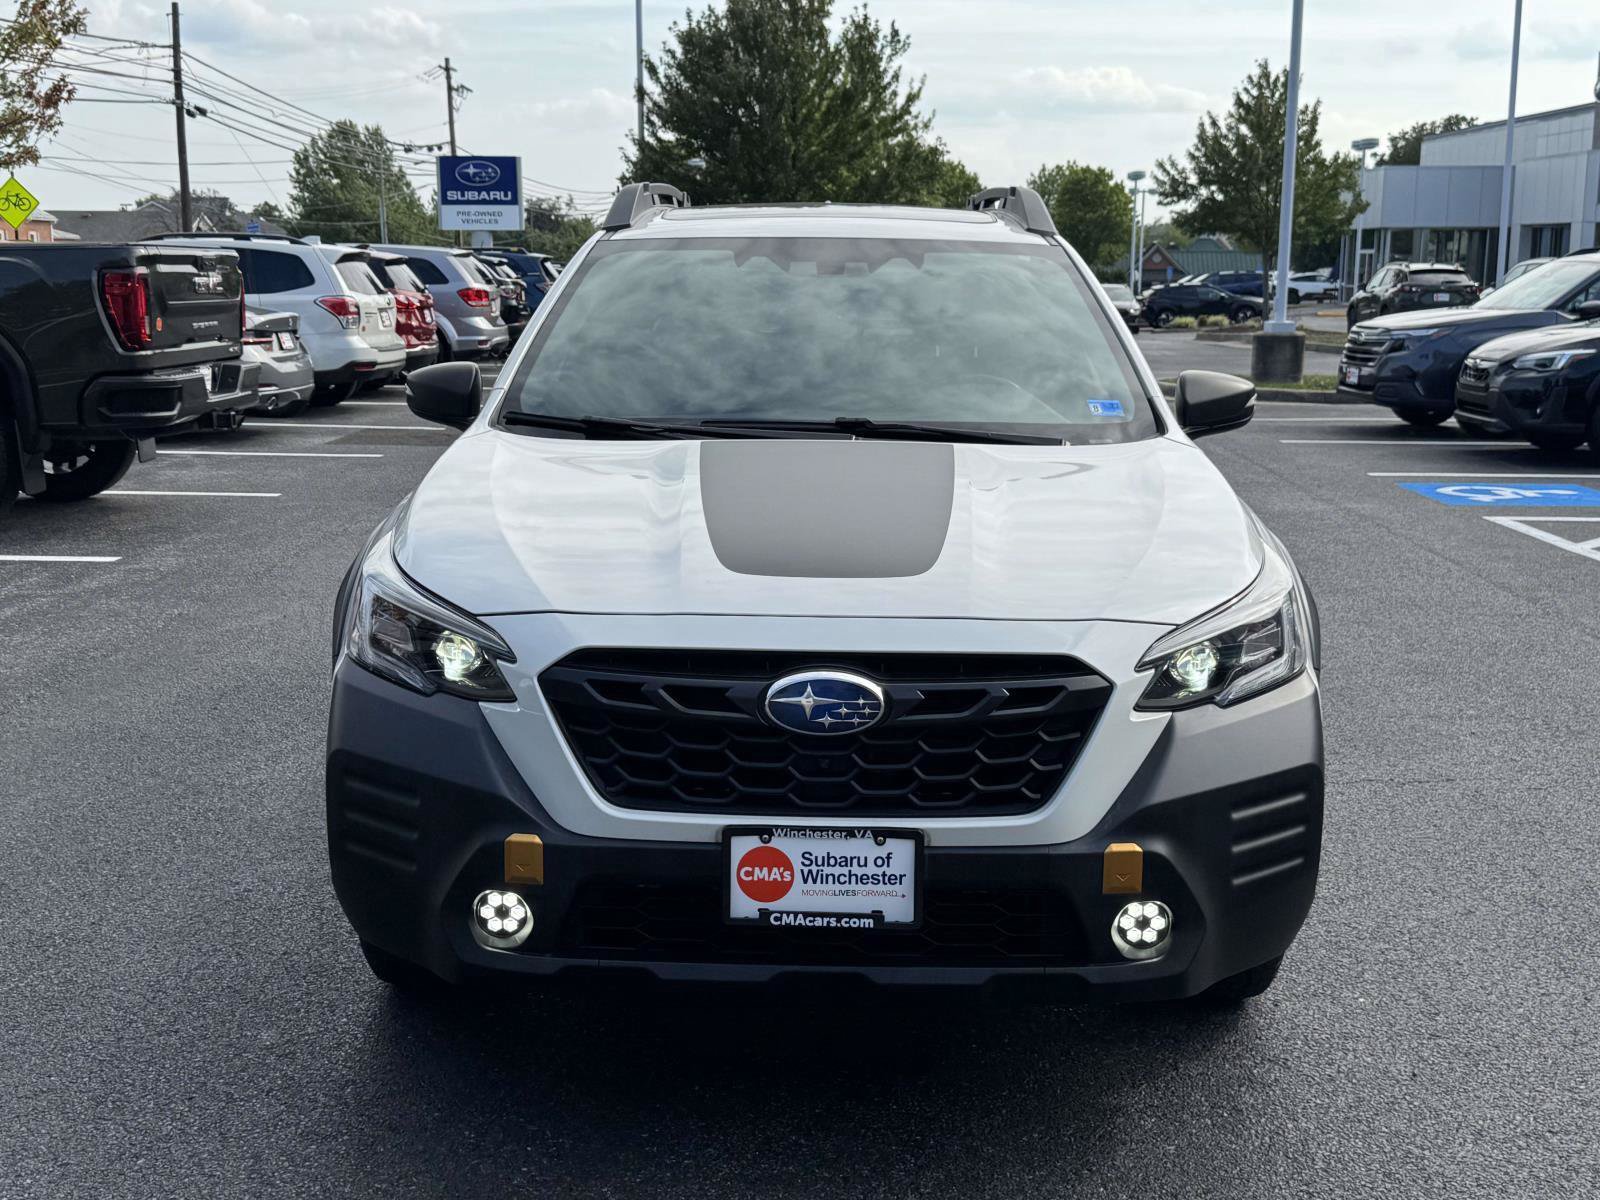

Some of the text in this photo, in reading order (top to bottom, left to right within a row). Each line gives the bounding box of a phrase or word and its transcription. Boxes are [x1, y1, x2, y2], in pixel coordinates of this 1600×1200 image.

[446, 190, 512, 201] SUBARU
[772, 828, 874, 840] Winchester, VA
[800, 851, 893, 868] Subaru of
[739, 866, 793, 882] CMA's
[800, 869, 907, 886] Winchester
[769, 913, 874, 928] CMAcars.com
